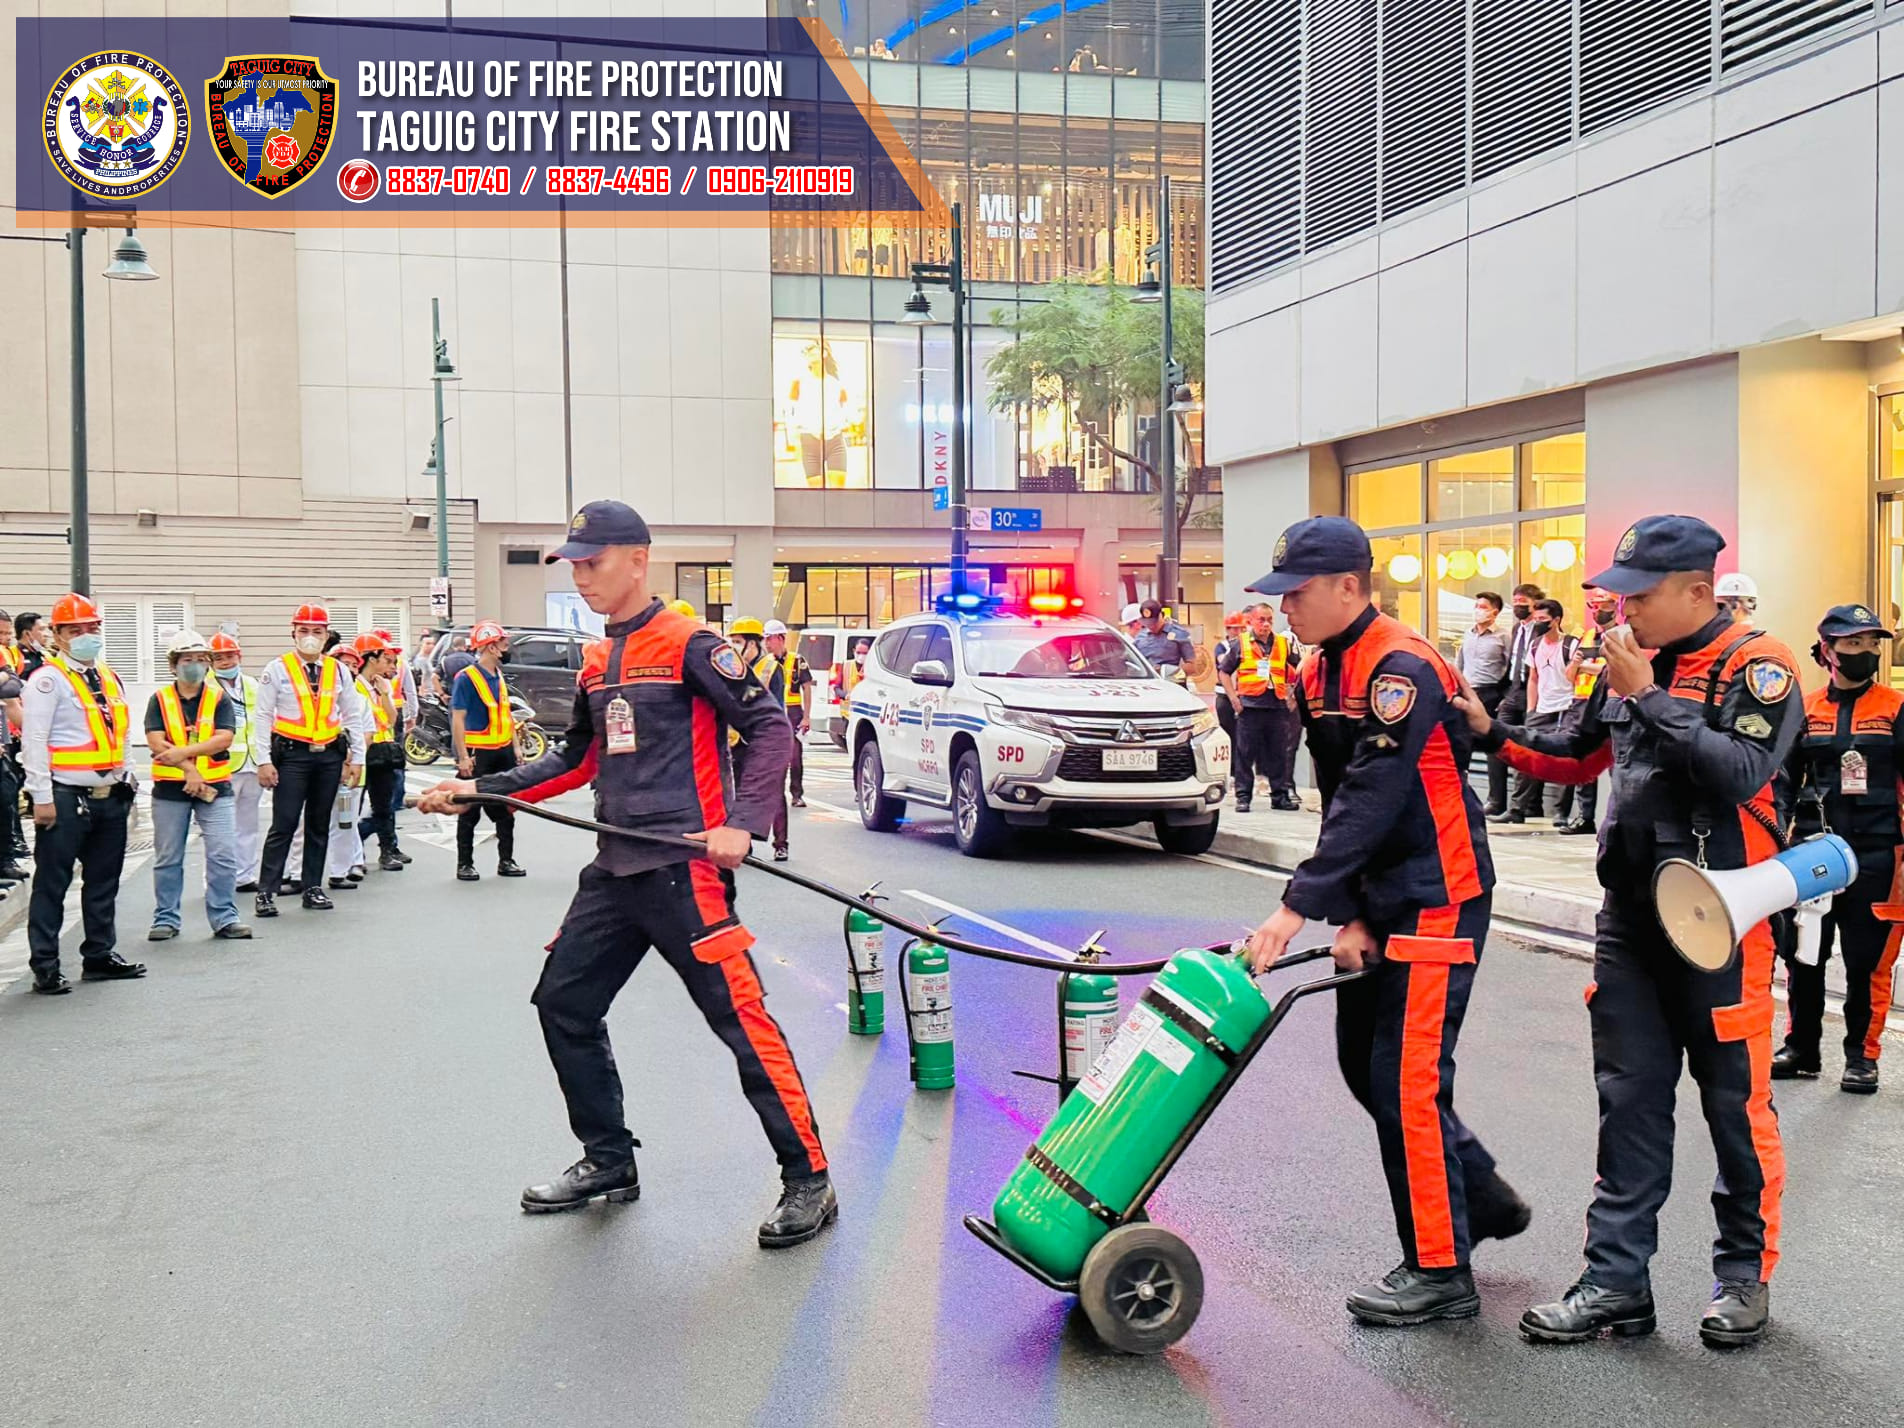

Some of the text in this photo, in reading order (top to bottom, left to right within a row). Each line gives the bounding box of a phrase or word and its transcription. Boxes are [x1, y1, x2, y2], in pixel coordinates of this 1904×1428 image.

[980, 193, 1042, 224] MUJI
[986, 224, 1038, 240] 無印品
[934, 431, 948, 486] DKNY
[880, 702, 899, 727] J-23
[921, 738, 935, 754] SPD
[997, 745, 1025, 763] SPD
[1105, 753, 1155, 766] SAA 9746
